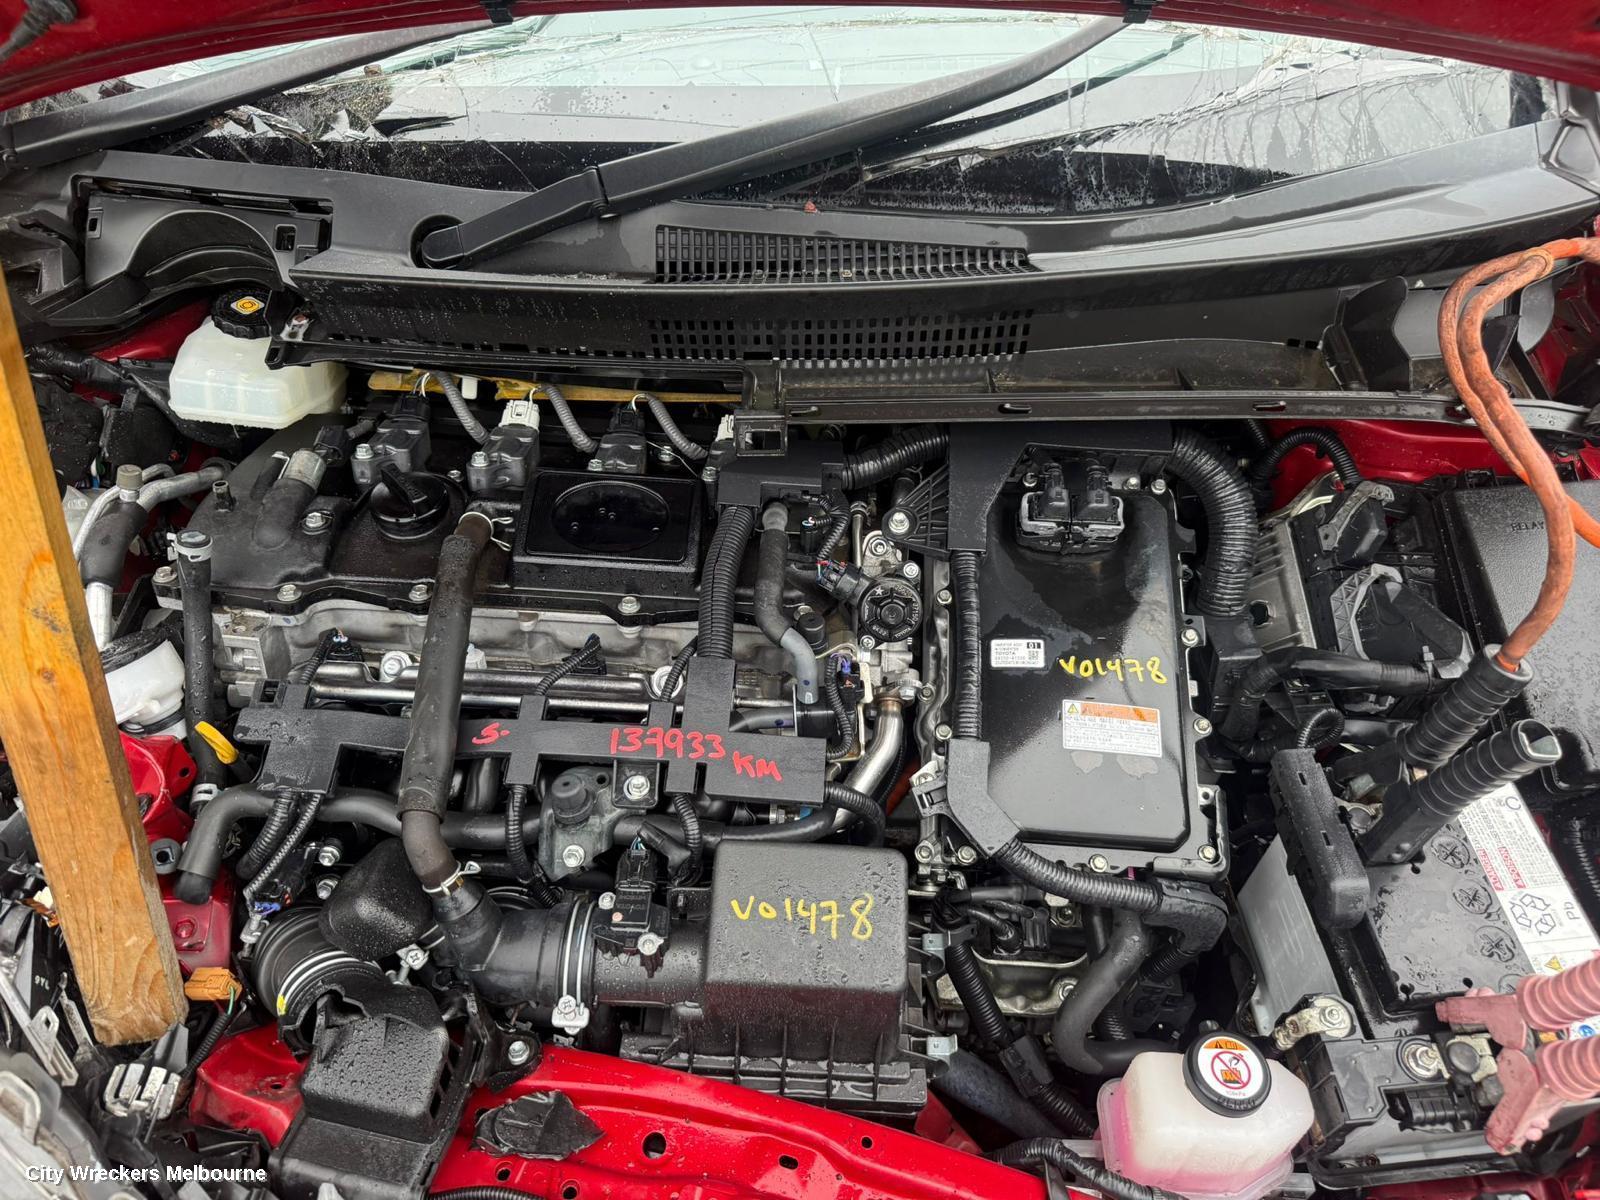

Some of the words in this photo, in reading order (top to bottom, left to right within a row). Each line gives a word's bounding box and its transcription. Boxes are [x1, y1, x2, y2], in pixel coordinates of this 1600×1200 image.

[1510, 521, 1544, 532] RELAY
[610, 727, 726, 759] 137933
[732, 751, 784, 782] KM
